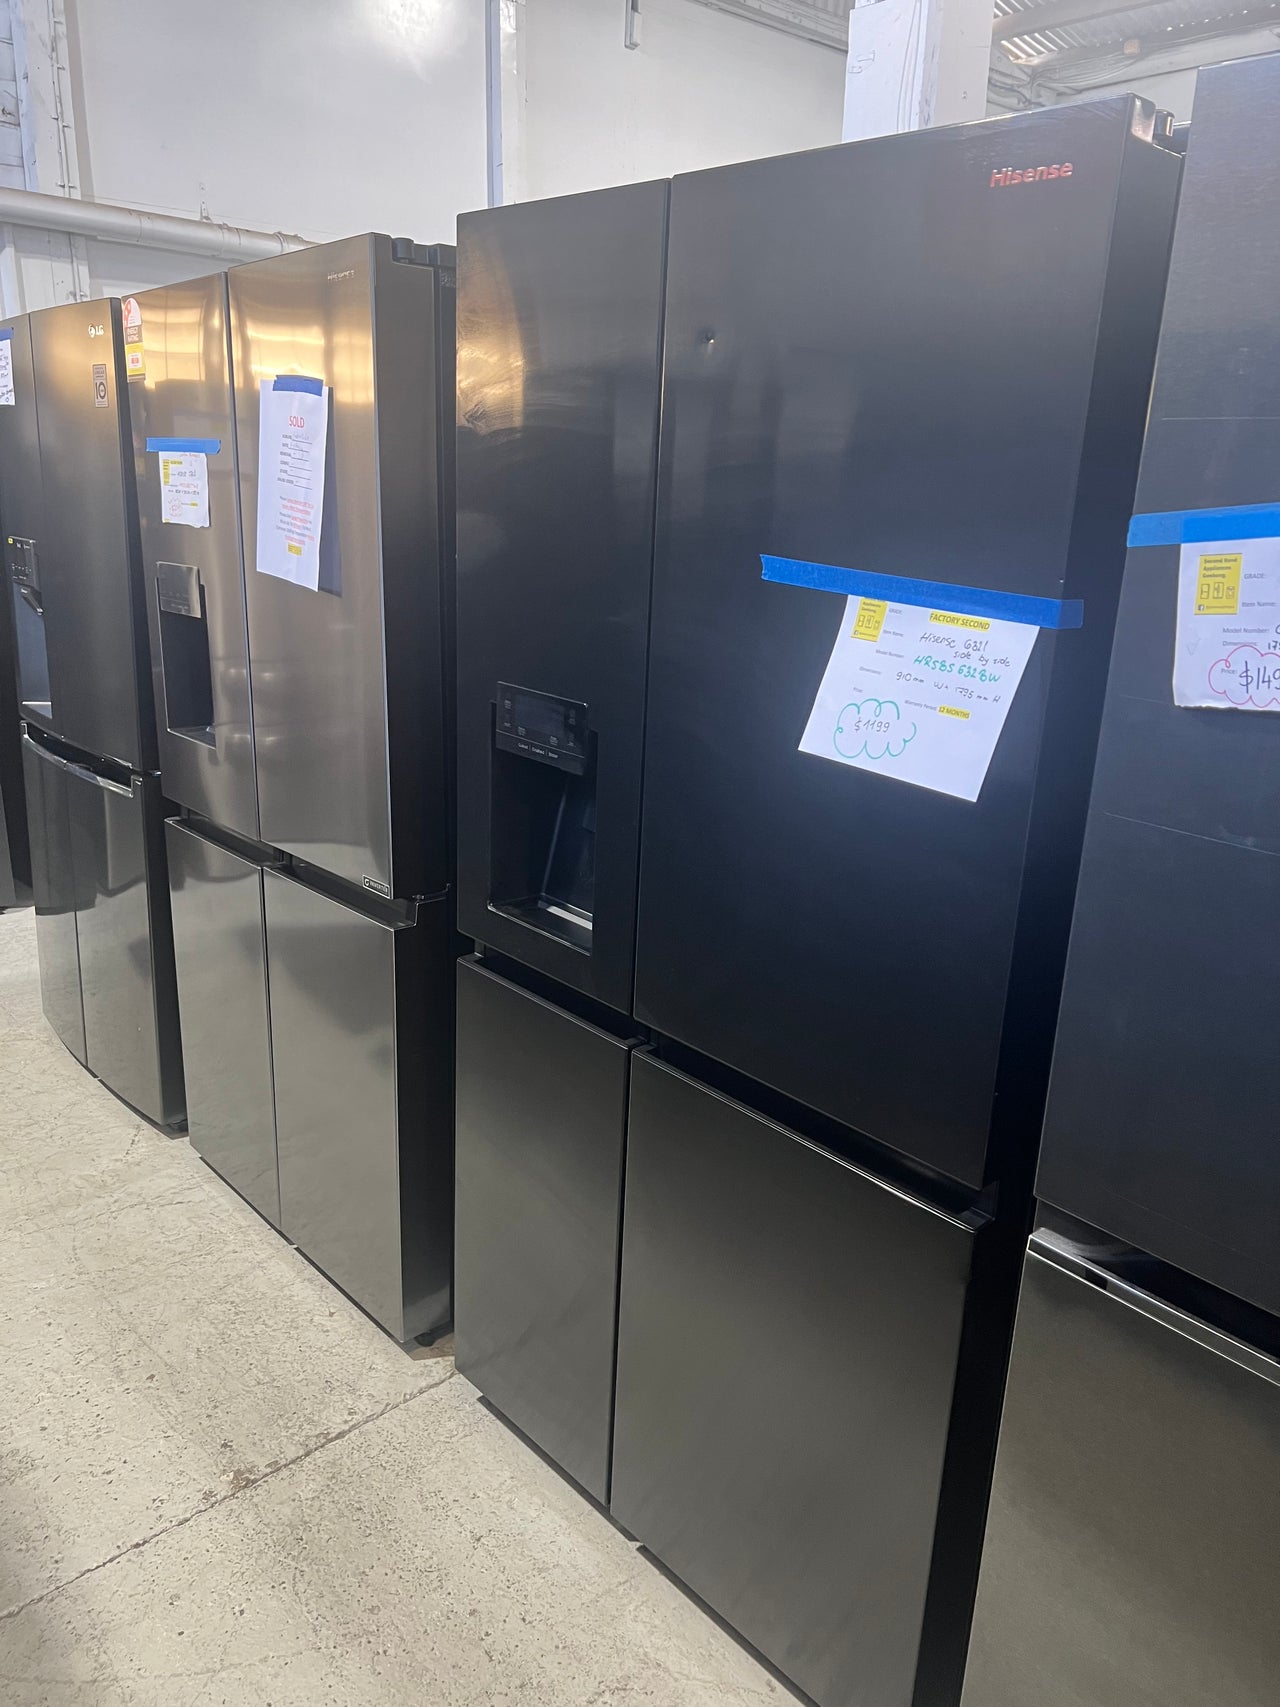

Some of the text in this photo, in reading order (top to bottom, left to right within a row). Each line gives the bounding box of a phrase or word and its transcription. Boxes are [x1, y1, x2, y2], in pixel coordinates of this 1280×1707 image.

[990, 162, 1073, 188] Hisense
[95, 325, 105, 336] LG
[289, 415, 305, 428] SOLD
[929, 612, 991, 631] FACTORY SECOND
[978, 652, 990, 667] by
[896, 671, 912, 682] 910
[854, 716, 891, 733] $1199
